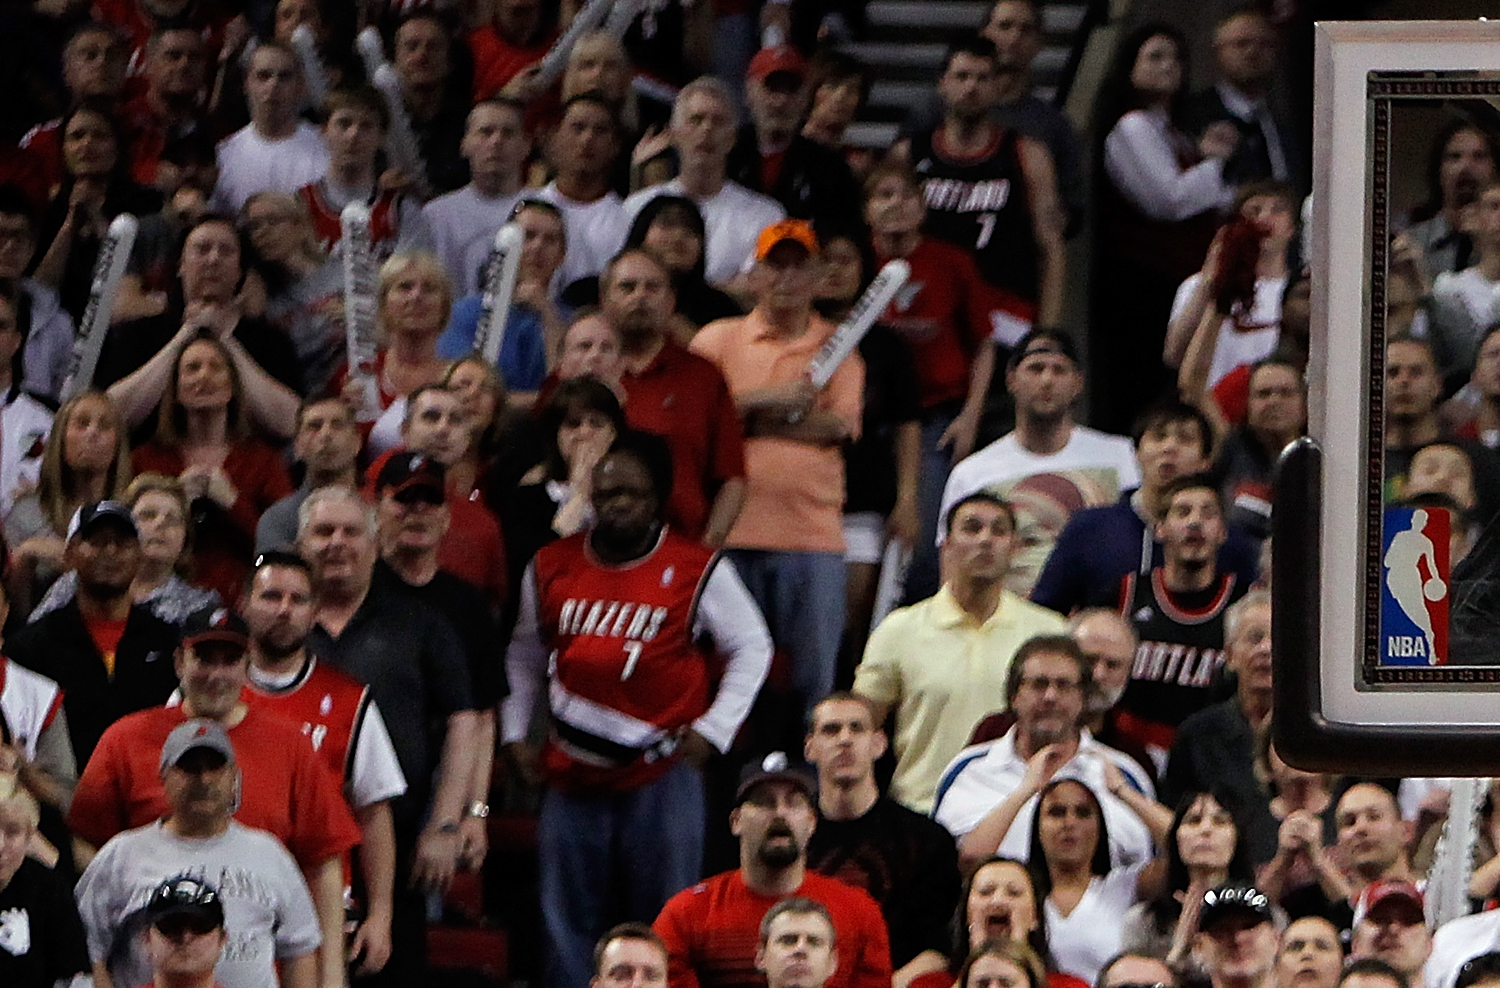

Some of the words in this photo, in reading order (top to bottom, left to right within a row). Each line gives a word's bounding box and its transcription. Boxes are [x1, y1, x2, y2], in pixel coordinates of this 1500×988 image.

[976, 213, 997, 249] 7
[558, 598, 668, 642] BLAZERS
[621, 640, 643, 681] 7
[1388, 636, 1426, 657] NBA
